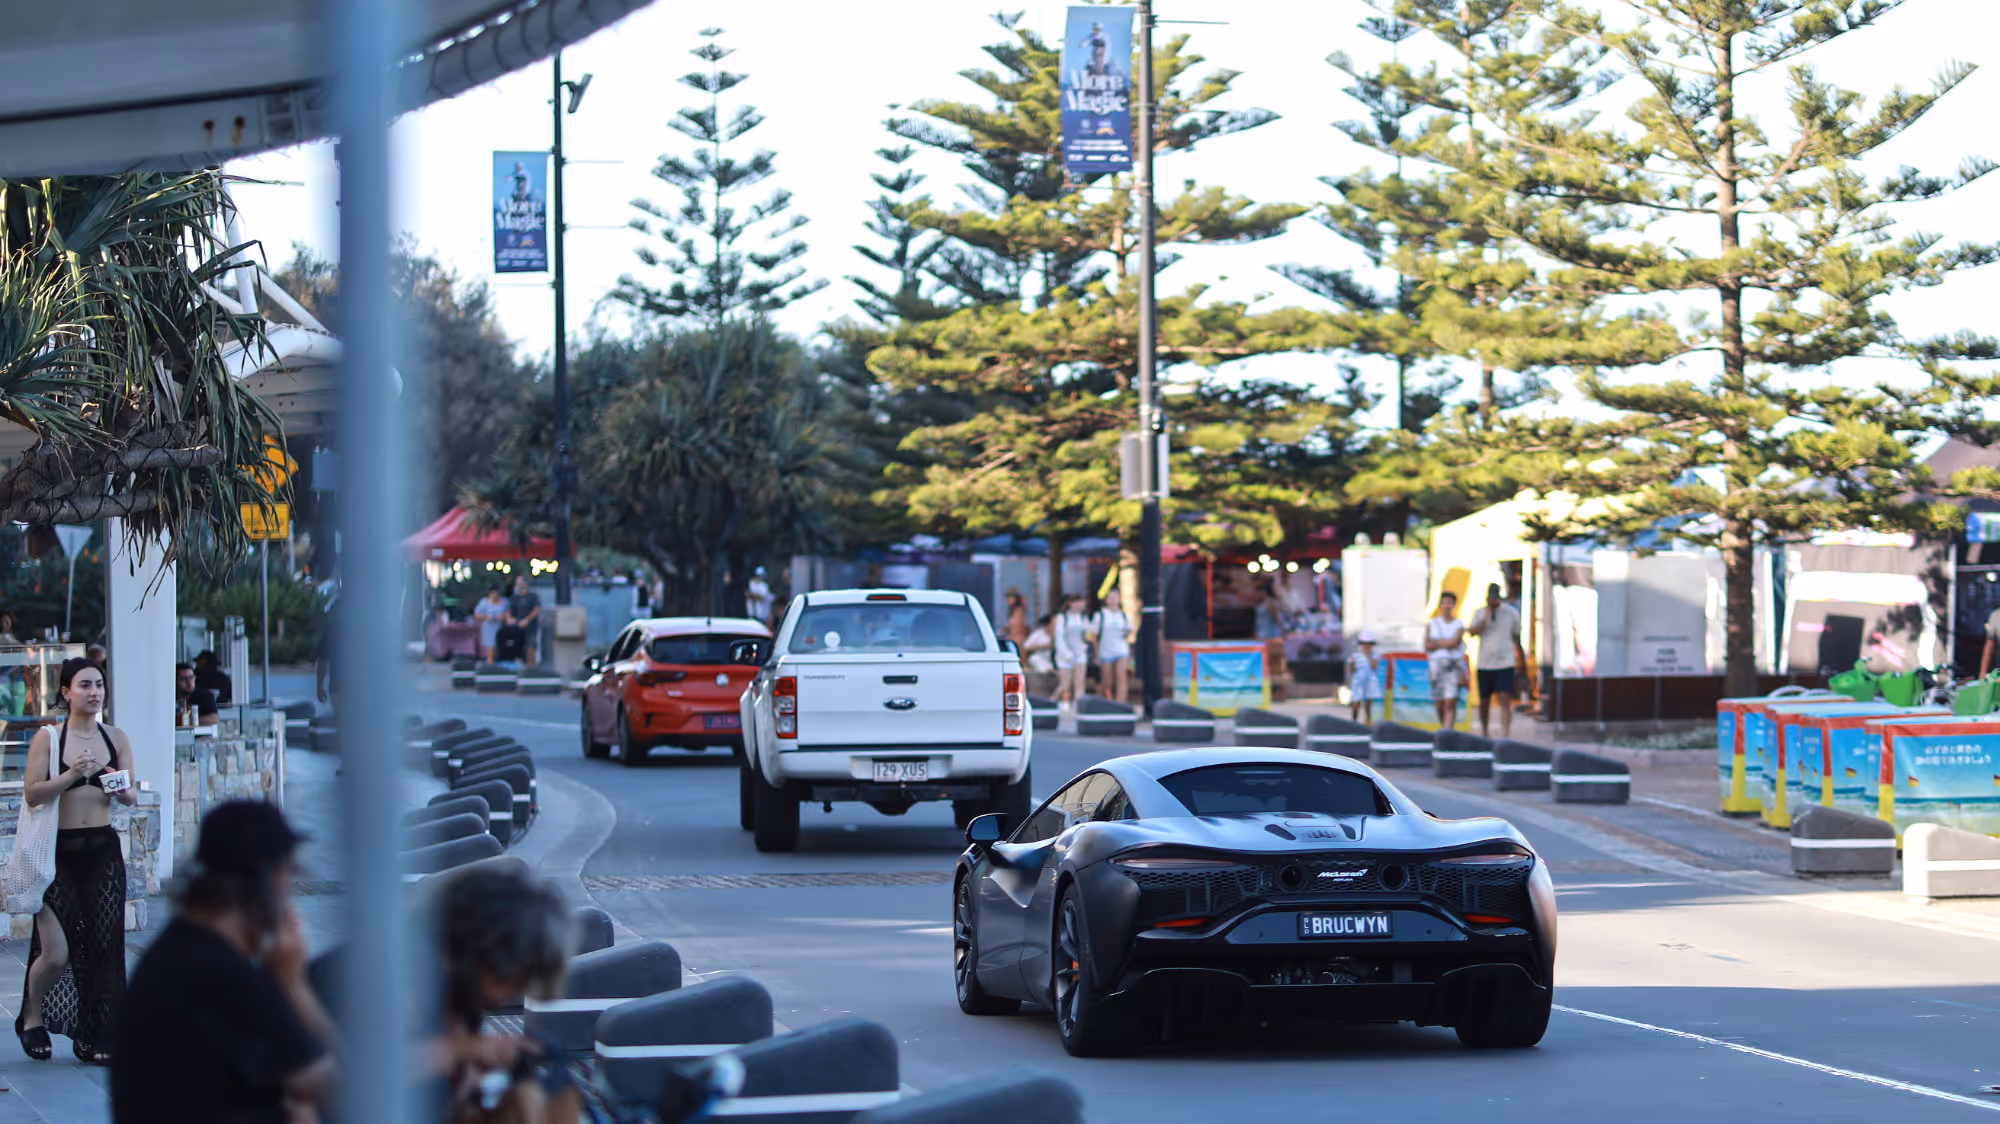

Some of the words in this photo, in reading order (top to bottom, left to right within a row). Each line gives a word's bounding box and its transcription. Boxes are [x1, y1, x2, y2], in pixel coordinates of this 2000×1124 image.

[1070, 70, 1124, 91] More
[1065, 90, 1128, 115] Magic
[496, 212, 545, 232] Magic
[876, 763, 897, 777] 129
[900, 763, 926, 777] XUS
[1317, 870, 1366, 878] McLaren
[1311, 915, 1388, 934] BRUCWYN
